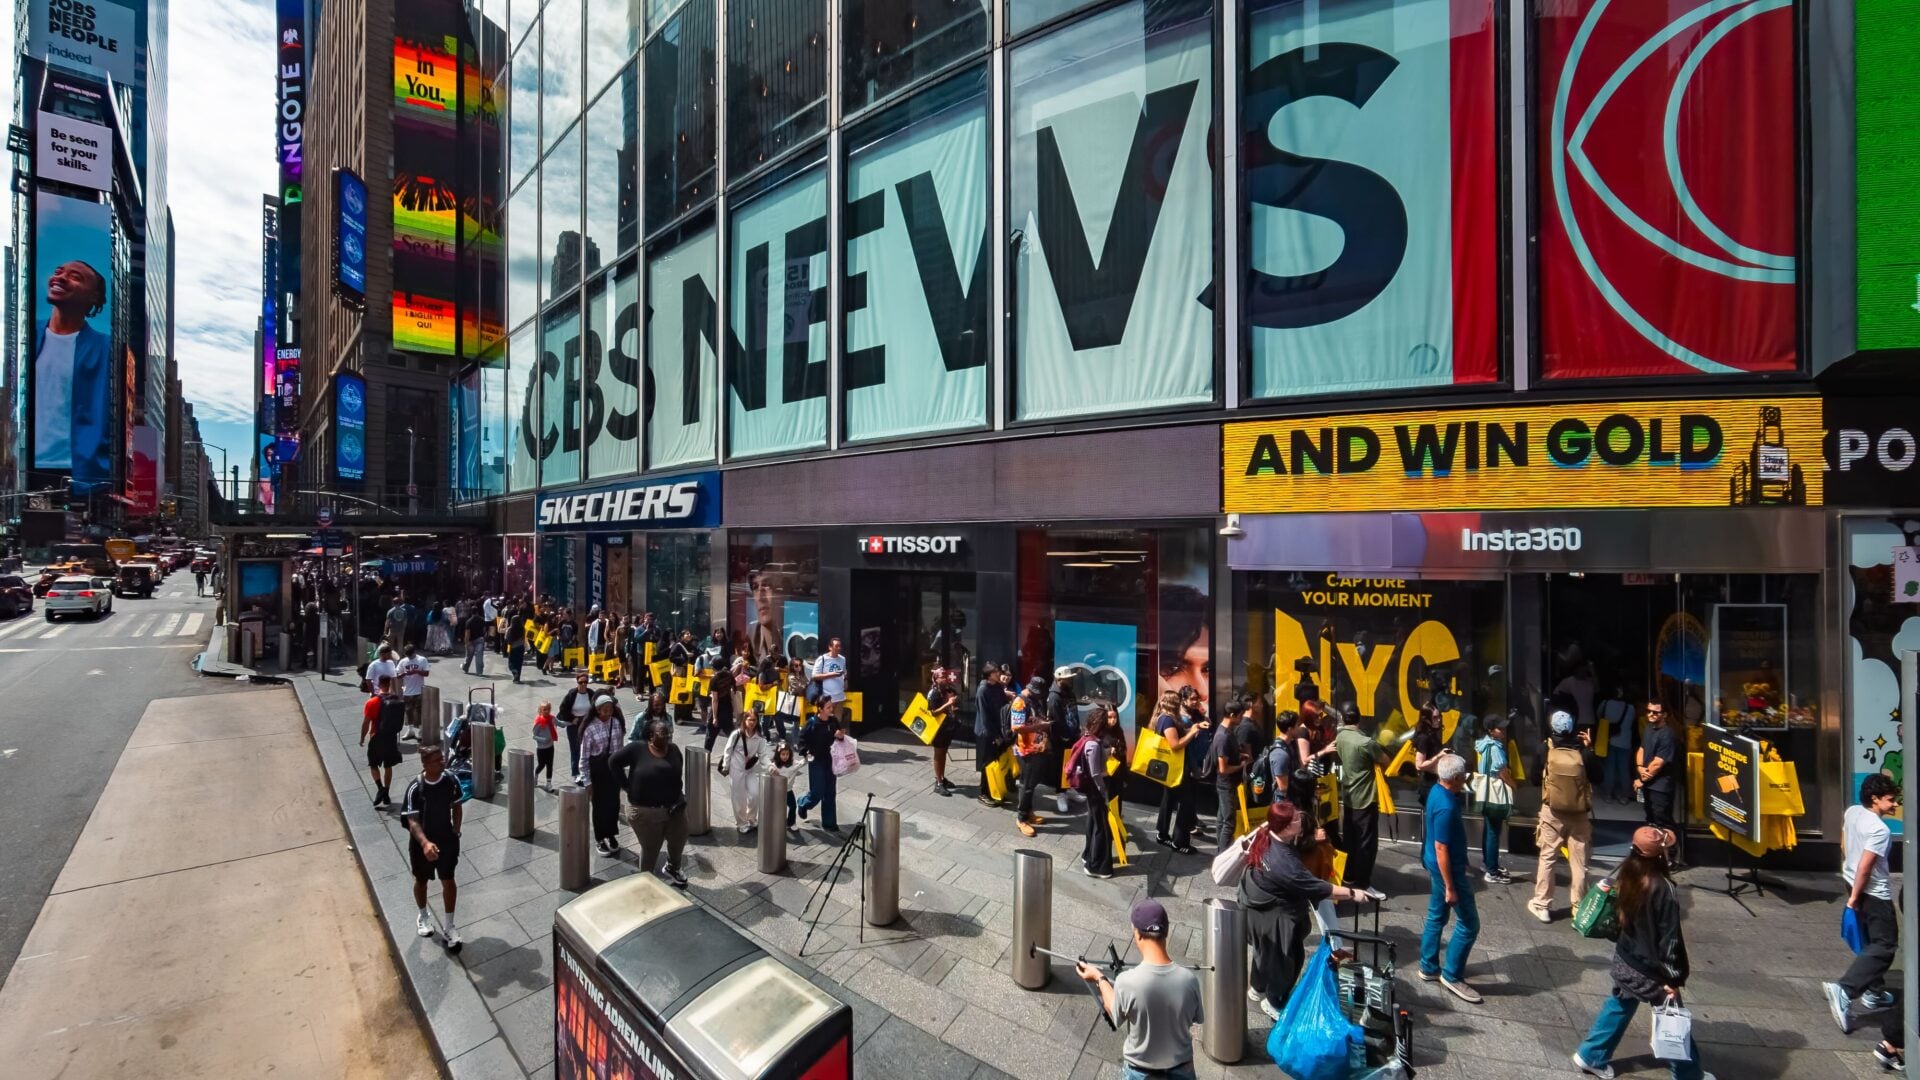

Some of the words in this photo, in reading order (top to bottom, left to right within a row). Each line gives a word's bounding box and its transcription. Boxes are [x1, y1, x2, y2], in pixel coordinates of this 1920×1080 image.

[49, 0, 96, 19] JOBS
[49, 7, 95, 31] NEED
[49, 21, 117, 53] PEOPLE
[48, 44, 92, 65] indeed
[406, 74, 445, 103] You.
[51, 128, 67, 140] Be
[69, 134, 98, 148] seen
[51, 142, 68, 154] for
[70, 147, 97, 160] your
[57, 157, 91, 172] skills.
[522, 301, 656, 461] CBS
[682, 42, 1408, 426] NEWS
[1245, 426, 1381, 476] AND
[1393, 421, 1528, 476] WIN
[1546, 413, 1723, 468] GOLD
[538, 480, 699, 526] SKECHERS
[883, 536, 962, 553] TISSOT
[1461, 527, 1582, 552] Insta360
[1326, 573, 1406, 589] CAPTURE
[1302, 591, 1349, 606] YOUR
[1353, 592, 1433, 608] MOMENT
[1275, 607, 1461, 745] NYC
[1708, 741, 1723, 753] GET
[1717, 761, 1739, 775] GOLD
[566, 951, 605, 1012] RIVETING
